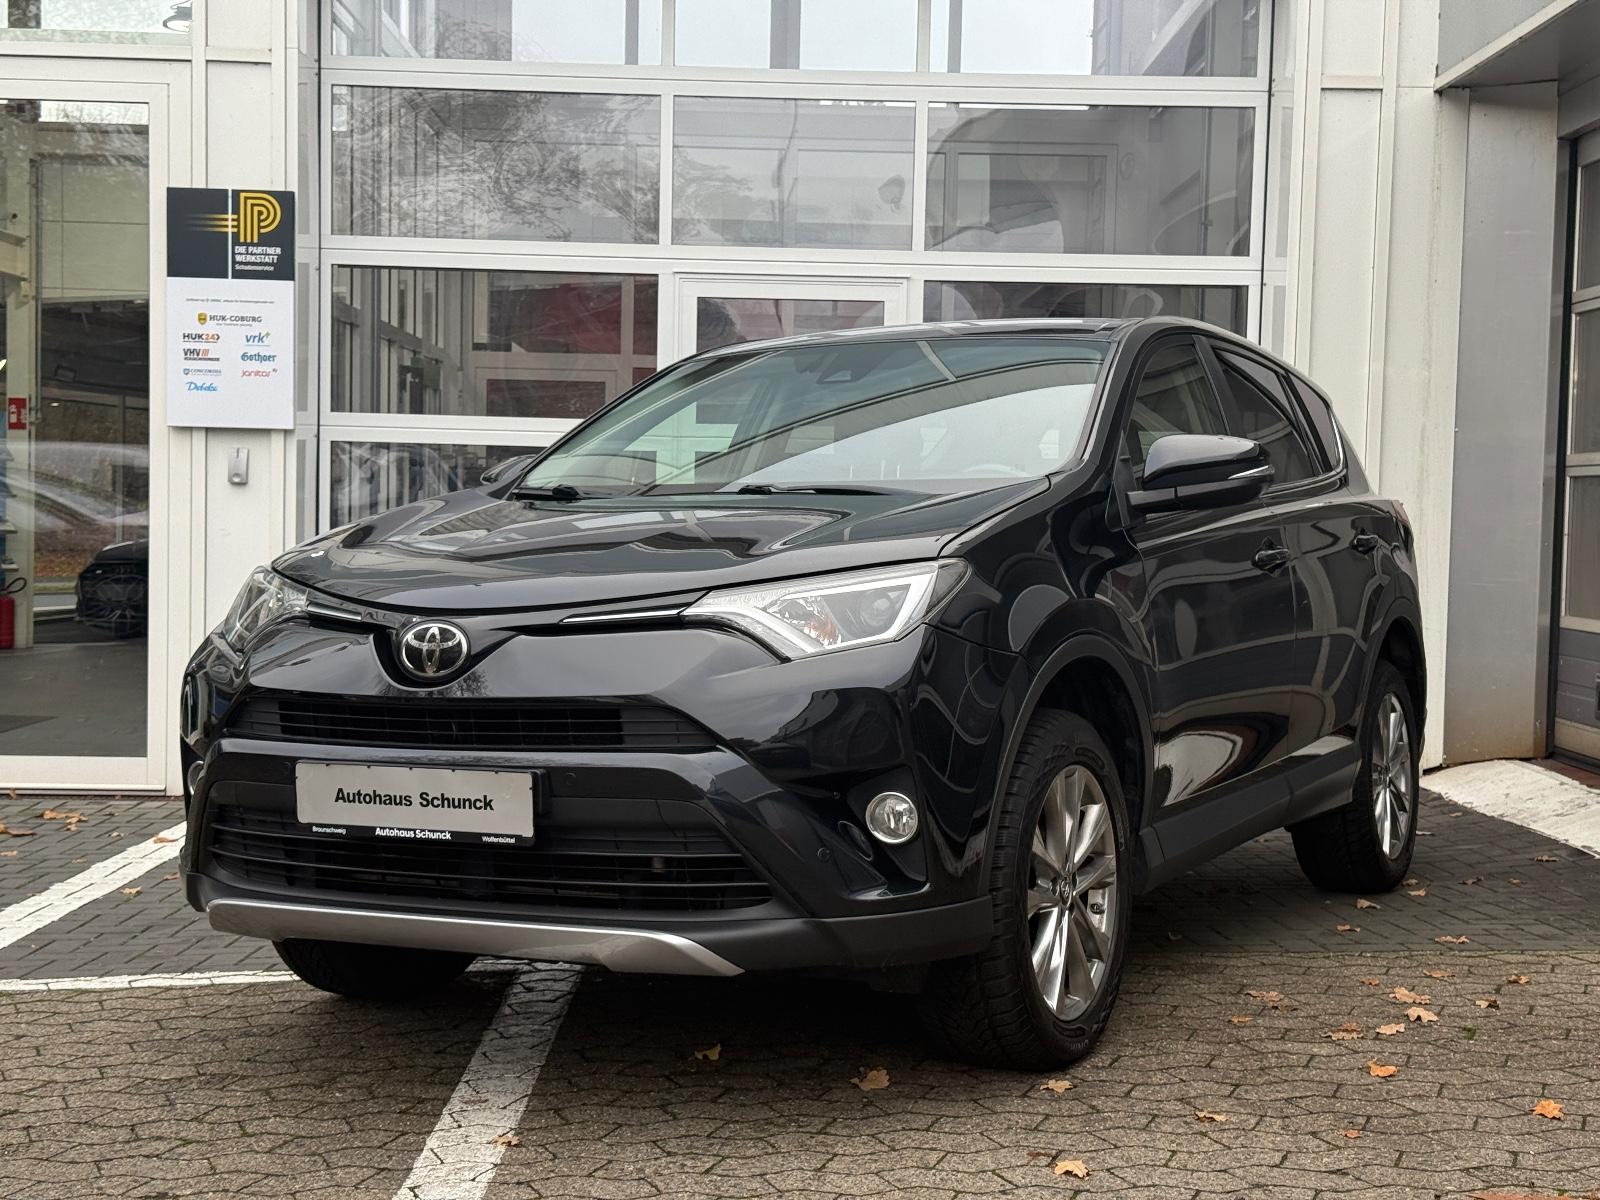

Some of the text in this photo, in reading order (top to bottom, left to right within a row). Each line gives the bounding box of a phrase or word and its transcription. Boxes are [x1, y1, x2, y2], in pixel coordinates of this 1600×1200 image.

[235, 246, 281, 254] DIE PARTNER
[235, 254, 279, 263] WERKSTATT
[209, 314, 262, 323] HUK-COBURG
[245, 332, 265, 343] vrk
[241, 352, 277, 363] Gothaer
[334, 787, 494, 811] Autohaus Schunck
[312, 825, 347, 835] Braunschweig
[375, 827, 452, 840] Autohaus Schunck
[481, 835, 516, 844] Wolfenbüttel
